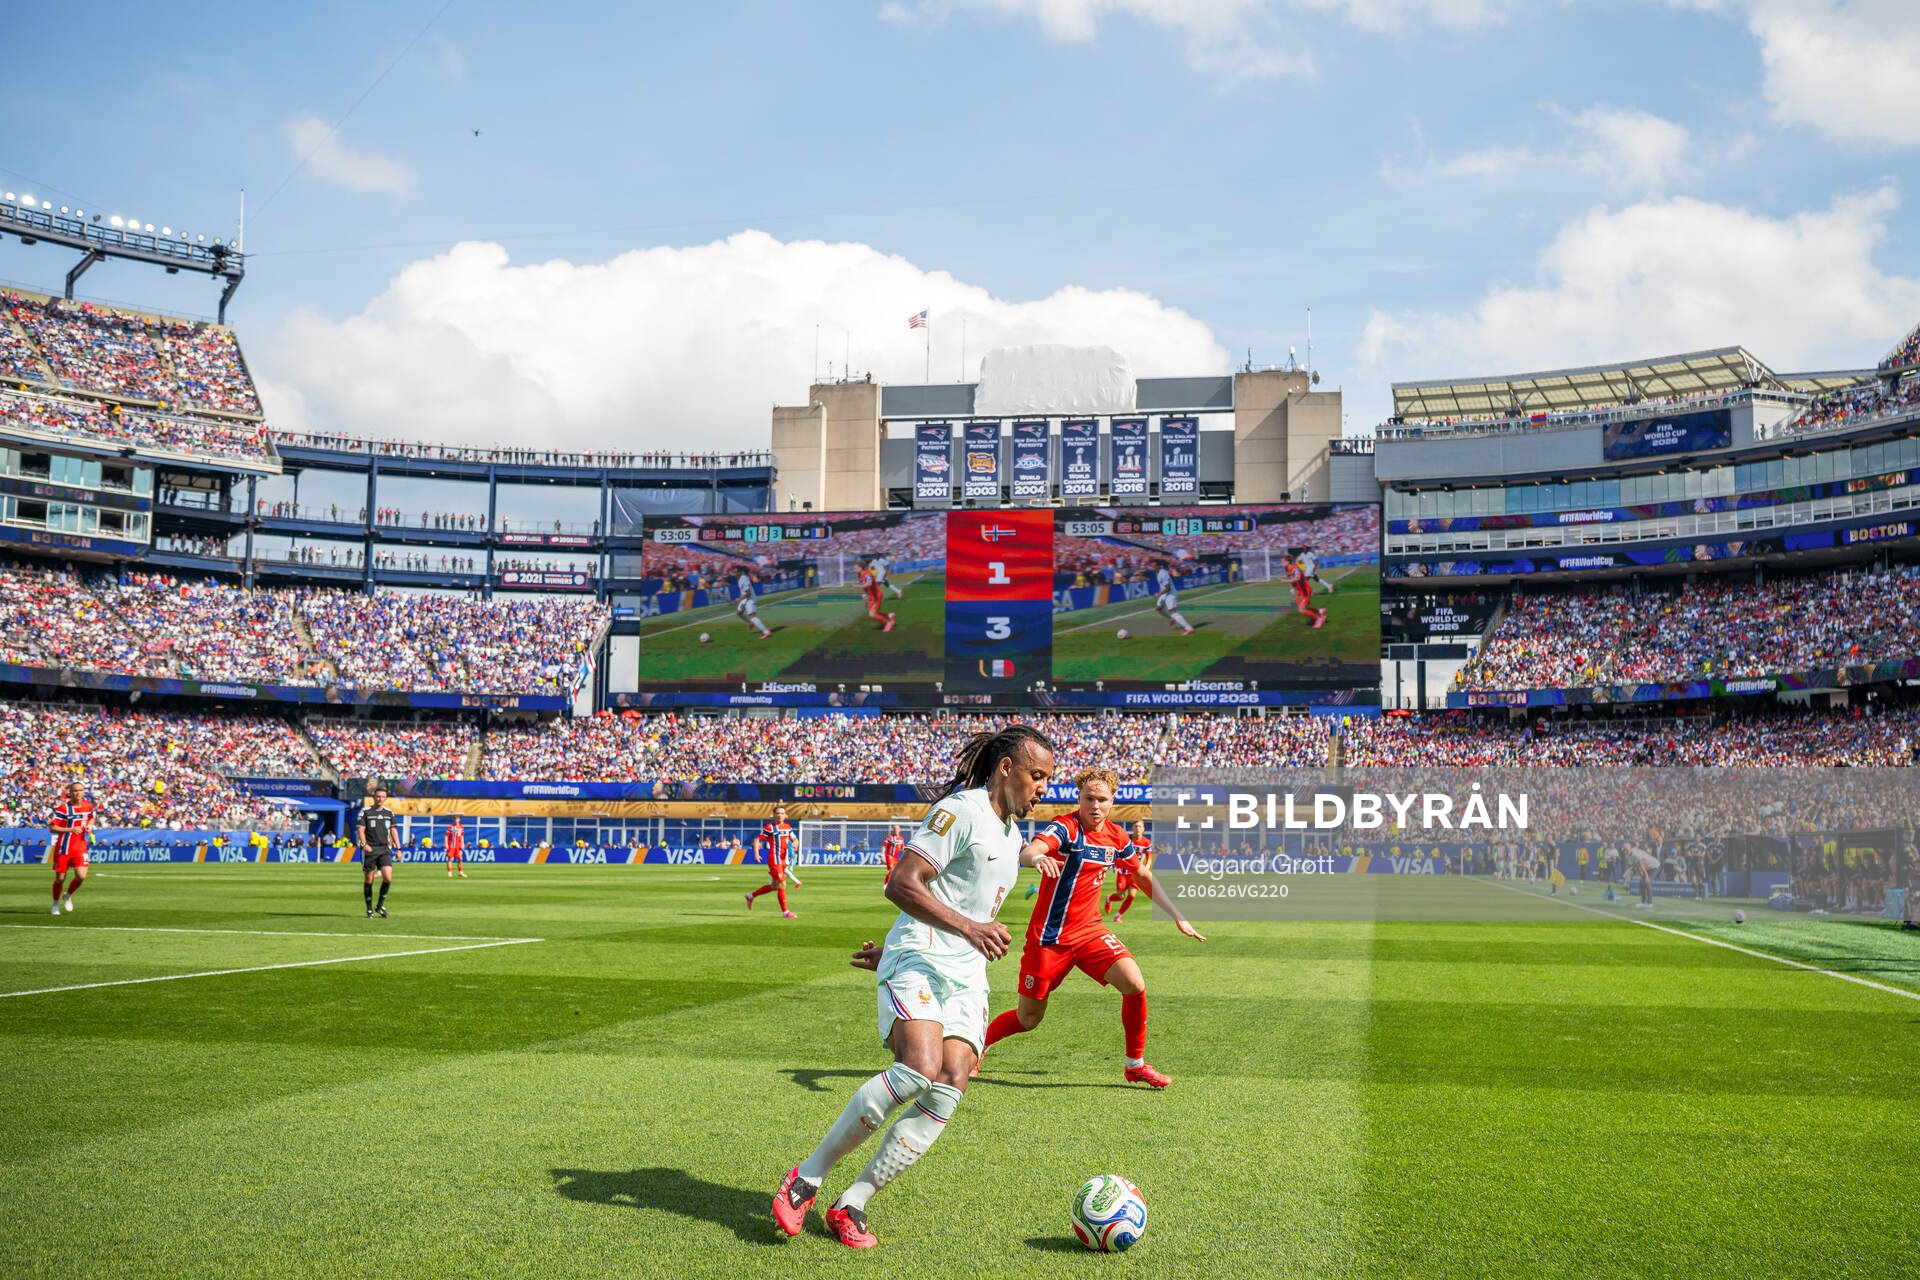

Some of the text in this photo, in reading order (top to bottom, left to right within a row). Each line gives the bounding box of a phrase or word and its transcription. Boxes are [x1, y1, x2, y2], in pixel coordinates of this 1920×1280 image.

[1657, 424, 1673, 432] FIFA
[1644, 429, 1687, 440] WORLD CUP
[1652, 438, 1678, 447] 2026
[918, 488, 947, 497] 2001
[966, 487, 997, 496] 2003
[1014, 486, 1046, 495] 2004
[1065, 485, 1094, 493] 2014
[1115, 484, 1144, 492] 2016
[1165, 483, 1193, 491] 2018
[1559, 511, 1613, 523] #FIFAWorldCup
[1072, 523, 1105, 533] 53:05
[1142, 522, 1159, 531] NOR
[1207, 521, 1223, 530] FRA
[1849, 522, 1908, 542] BOSTON
[660, 530, 691, 540] 53:05
[725, 530, 742, 539] NOR
[772, 530, 778, 538] 3
[786, 528, 801, 538] FRA
[1560, 556, 1613, 568] #FIFAWorldCup
[519, 573, 542, 584] 2021
[988, 562, 1011, 584] 1
[985, 616, 1011, 640] 3
[1429, 623, 1460, 631] 2026
[200, 684, 257, 698] #FIFAWorldCup
[762, 682, 816, 692] Hisense
[1186, 680, 1243, 691] Hisense
[1726, 679, 1777, 693] #FIFAWorldCup
[461, 696, 519, 708] BOSTON
[1126, 693, 1259, 703] FIFA WORLD CUP 2026
[1468, 692, 1527, 705] BOSTON
[523, 785, 580, 796] #FIFAWorldCup
[794, 786, 855, 798] BOSTON
[1115, 787, 1143, 798] CUP
[0, 845, 24, 863] ISA
[88, 848, 106, 863] tap
[108, 846, 119, 861] in
[122, 846, 146, 861] with
[148, 848, 170, 861] VISA
[218, 847, 243, 862] VISA
[278, 848, 309, 863] VISA
[392, 850, 412, 863] ap
[414, 848, 427, 861] in
[465, 849, 496, 861] VISA
[566, 848, 607, 864] VISA
[665, 849, 705, 864] VISA
[805, 850, 820, 864] in
[823, 850, 856, 864] with
[857, 851, 884, 864] VIS
[1389, 858, 1435, 874] VISA
